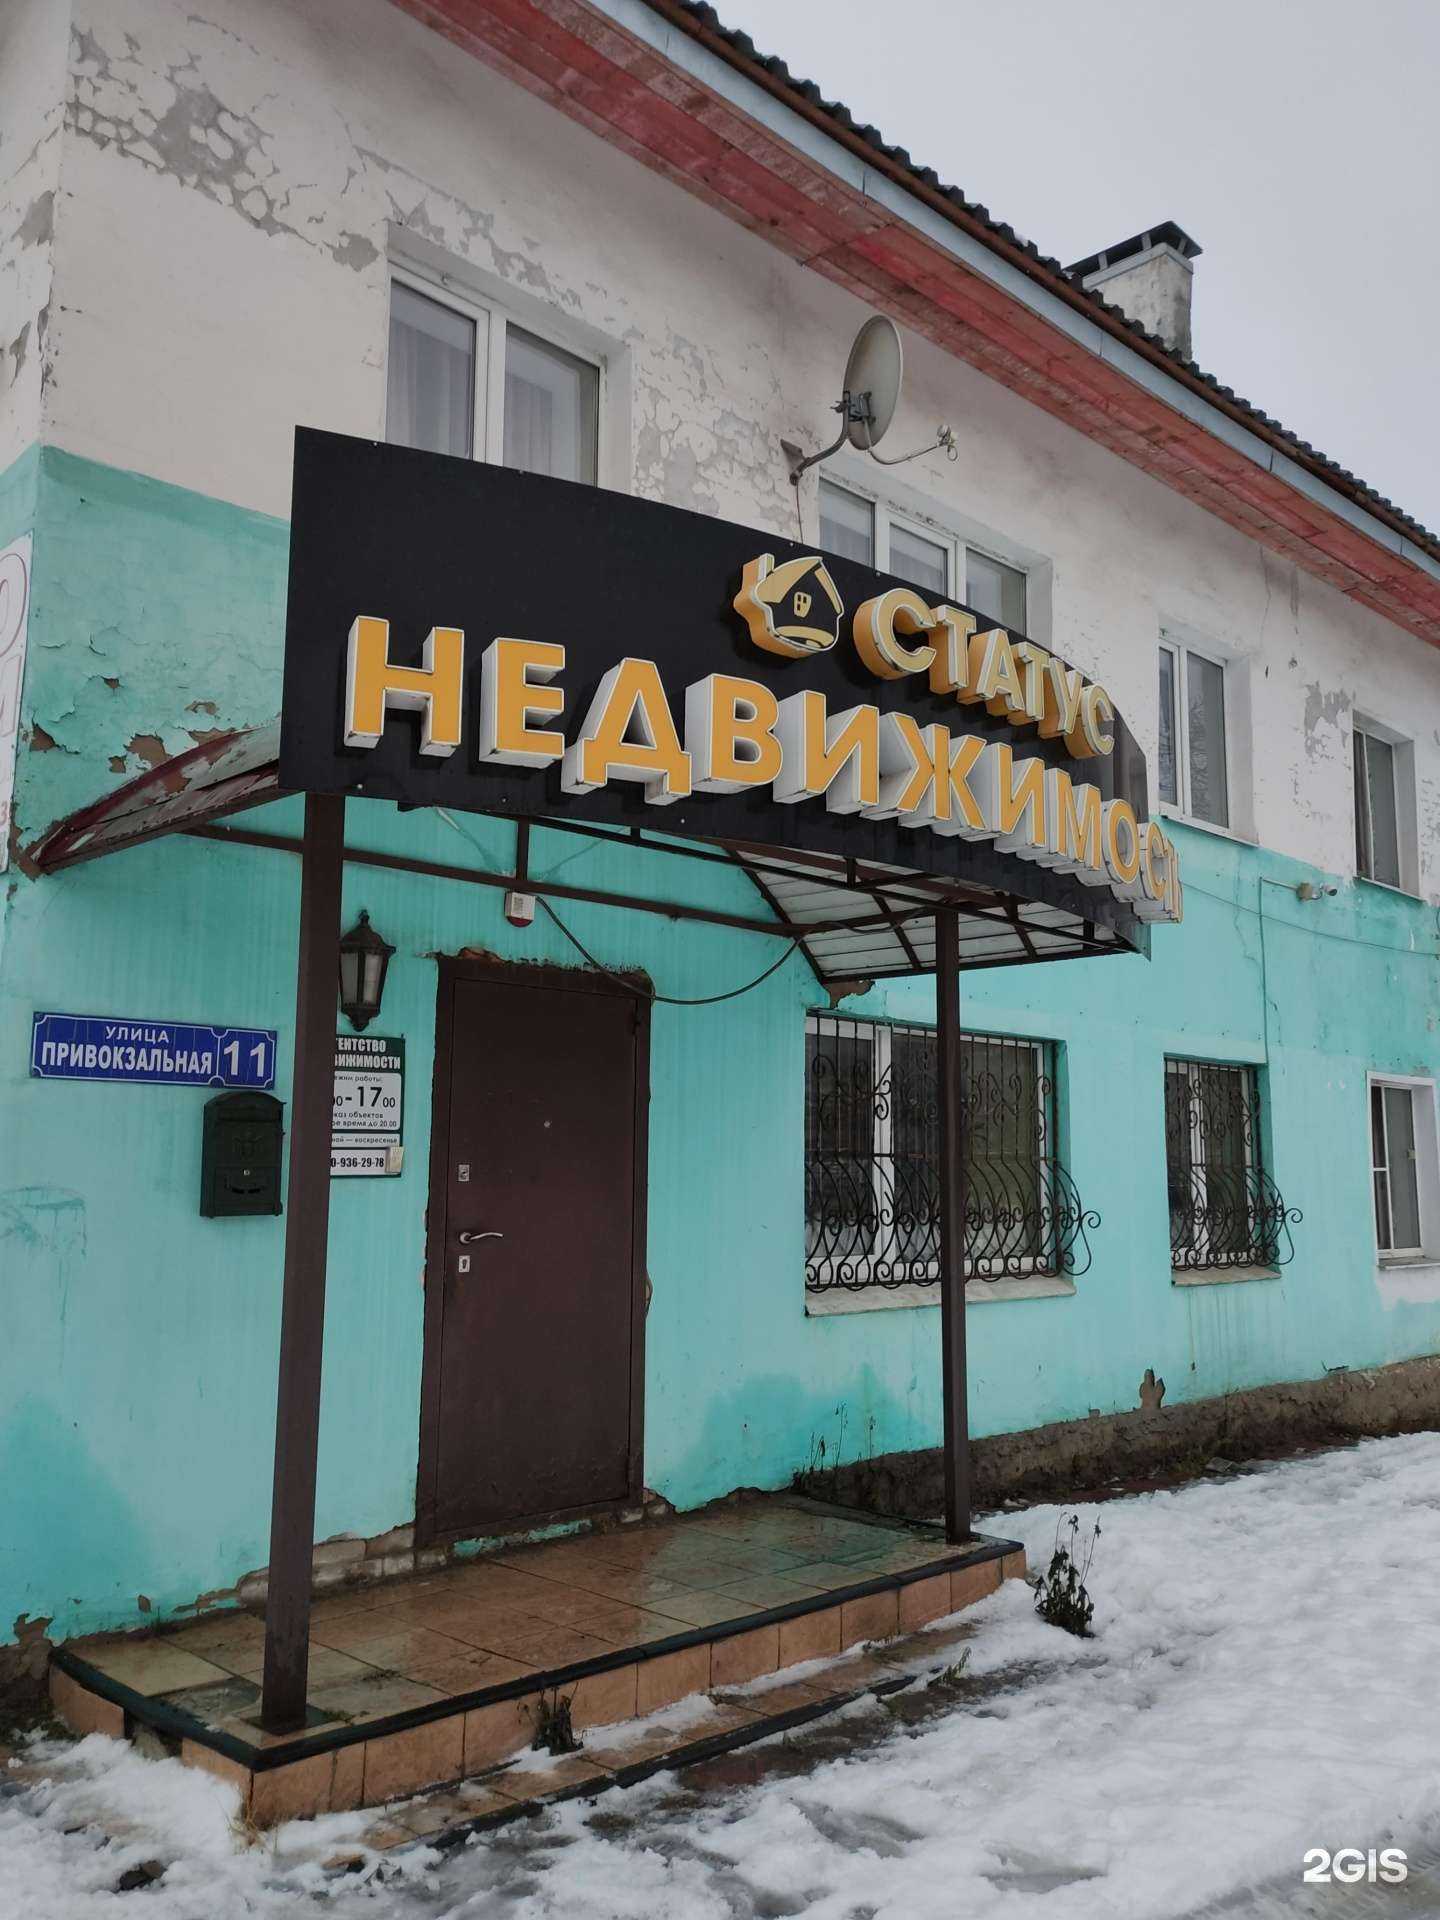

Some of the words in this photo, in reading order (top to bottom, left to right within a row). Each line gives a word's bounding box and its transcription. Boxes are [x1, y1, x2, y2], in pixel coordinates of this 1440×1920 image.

[853, 588, 1115, 759] СТАТУС
[105, 1026, 170, 1044] УЛИЦА
[336, 1037, 387, 1052] ЕНТСТВО
[42, 1041, 212, 1074] ПРИВОКЗАЛЬНАЯ
[223, 1040, 266, 1077] 11
[335, 1053, 401, 1069] ИЖИМОСТИ
[348, 1111, 384, 1119] объектов
[331, 1157, 385, 1168] 0-936-29-78
